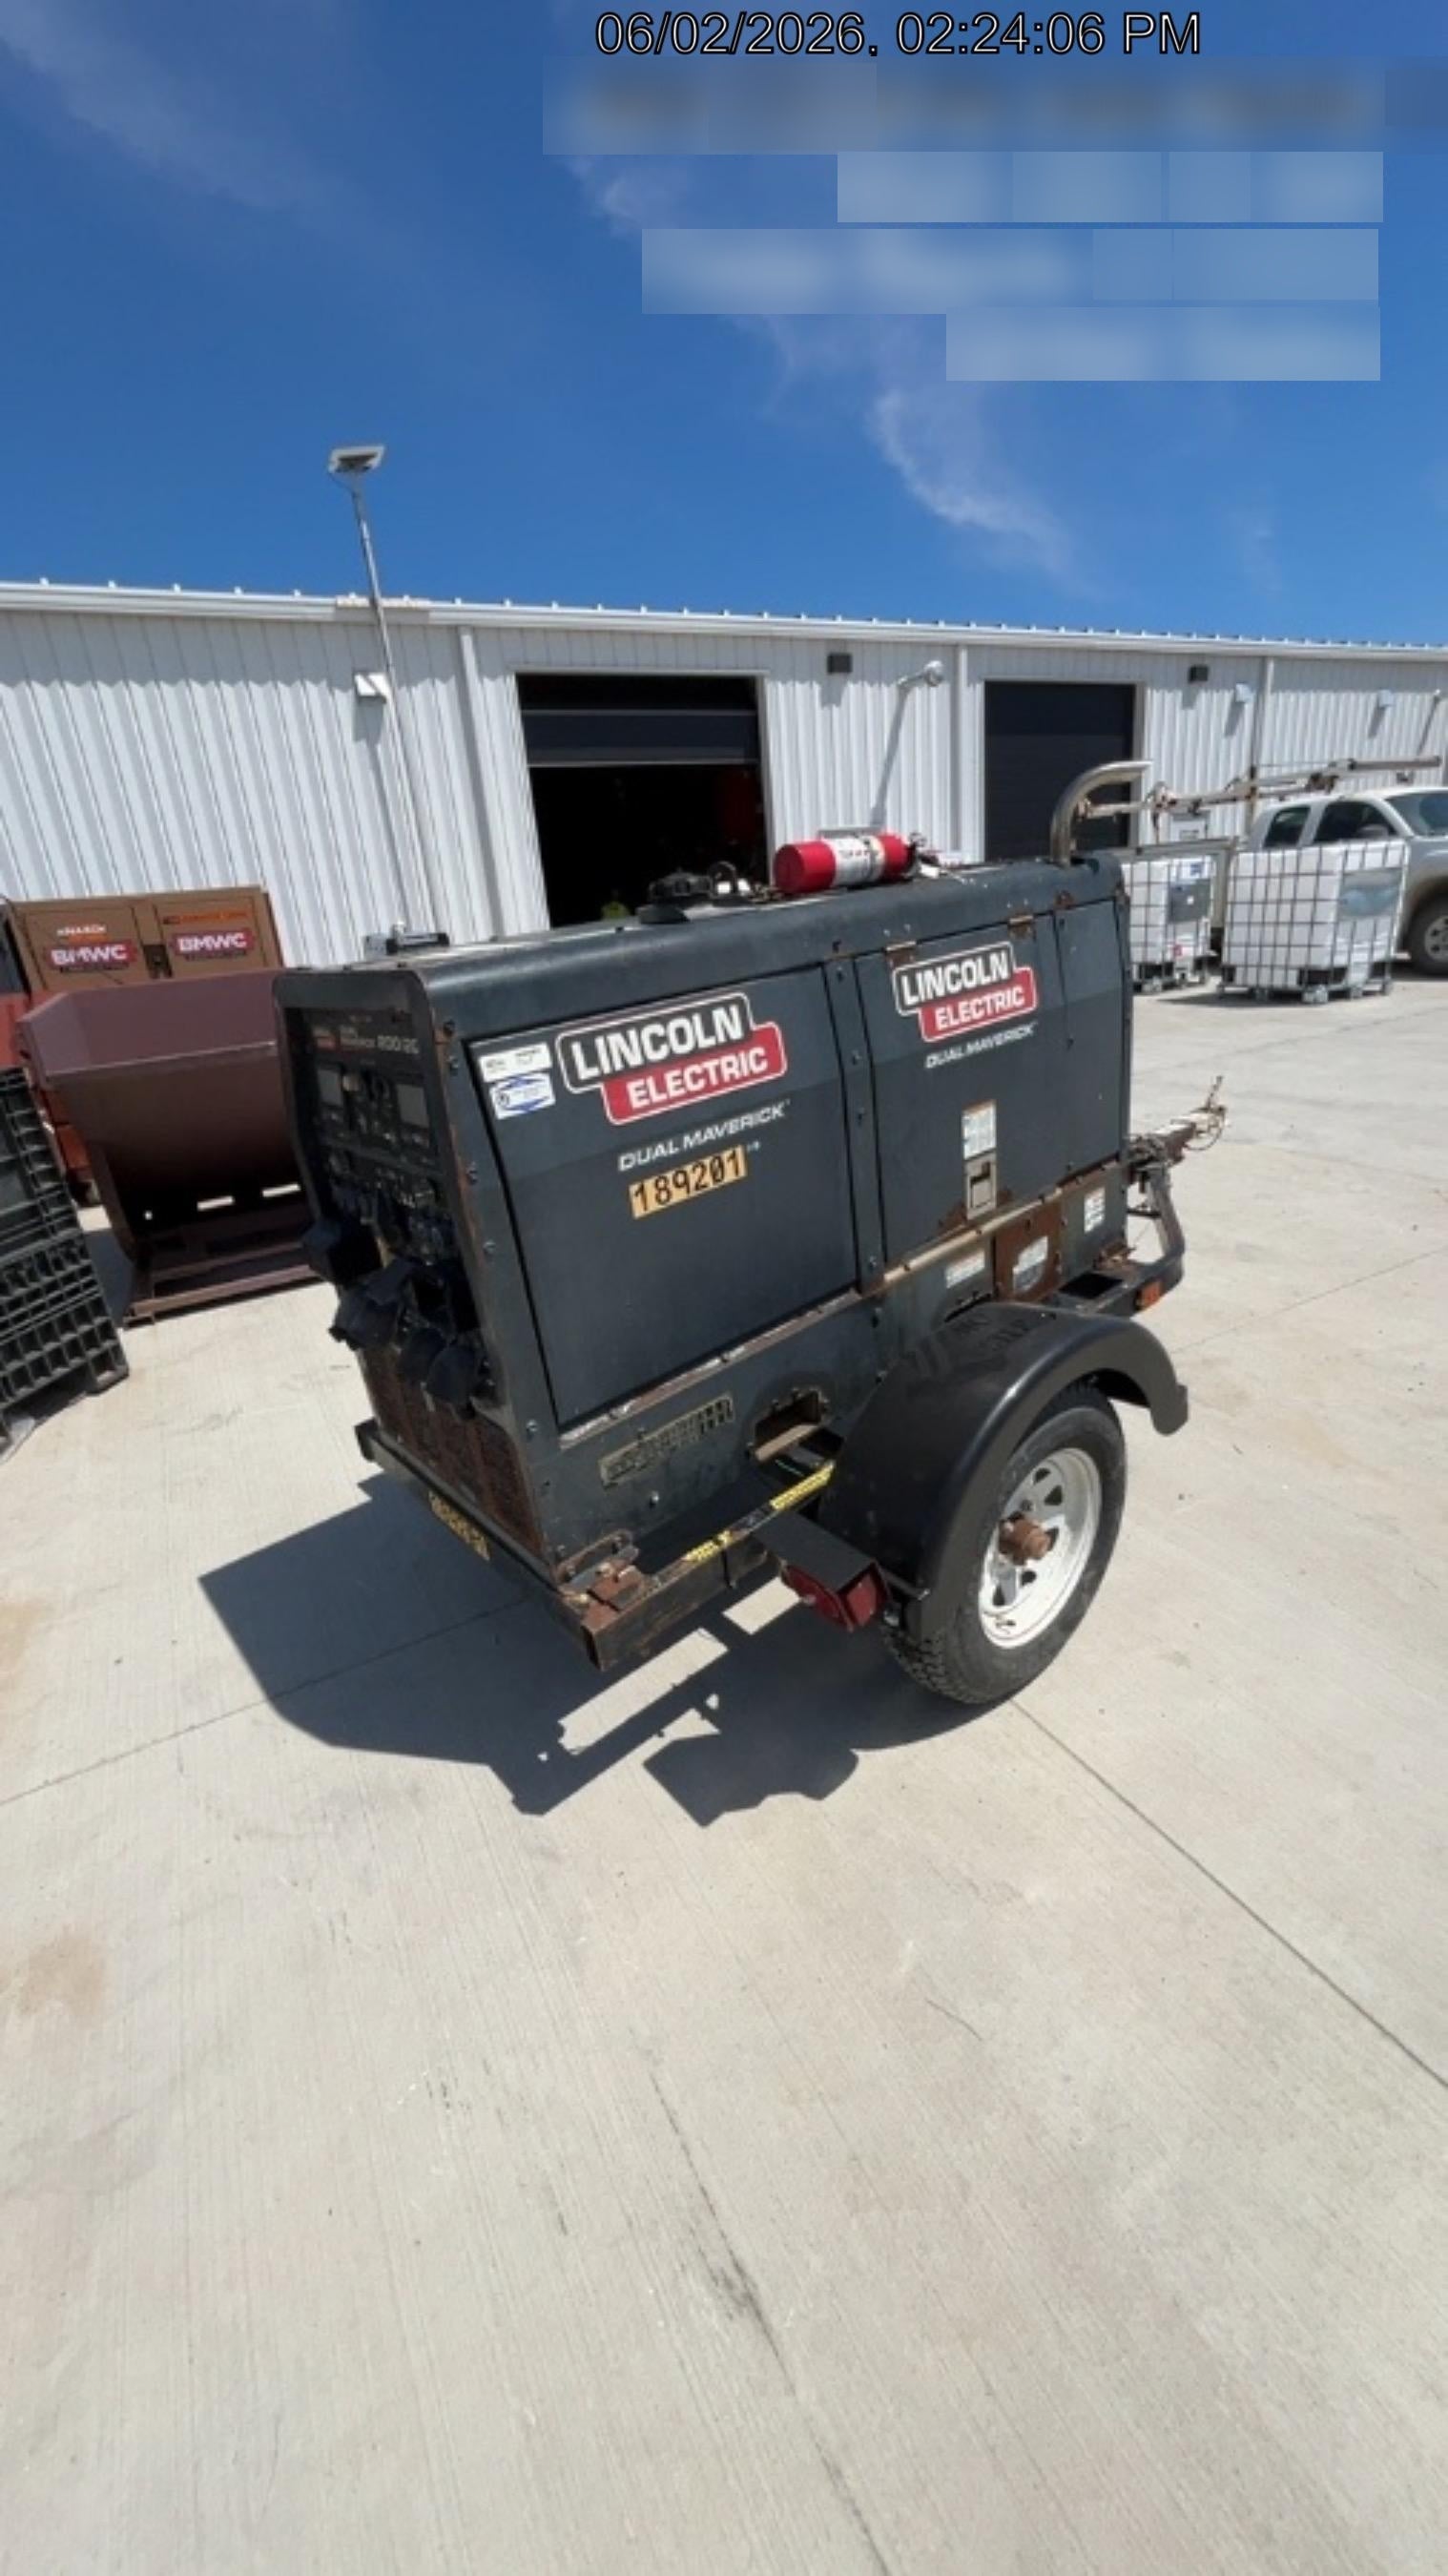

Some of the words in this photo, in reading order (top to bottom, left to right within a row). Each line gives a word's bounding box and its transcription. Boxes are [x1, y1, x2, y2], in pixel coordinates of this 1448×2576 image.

[51, 944, 128, 966] BMWC
[177, 932, 248, 952] BMWC
[900, 950, 1009, 1006] LINCOLN
[934, 986, 1025, 1031] ELECTRIC
[571, 1005, 744, 1080] LINCOLN
[924, 1047, 964, 1069] DUAL
[626, 1048, 769, 1110] ELECTRIC
[617, 1140, 681, 1172] DUAL
[682, 1102, 786, 1153] MAVERICK
[633, 1150, 743, 1213] 189201
